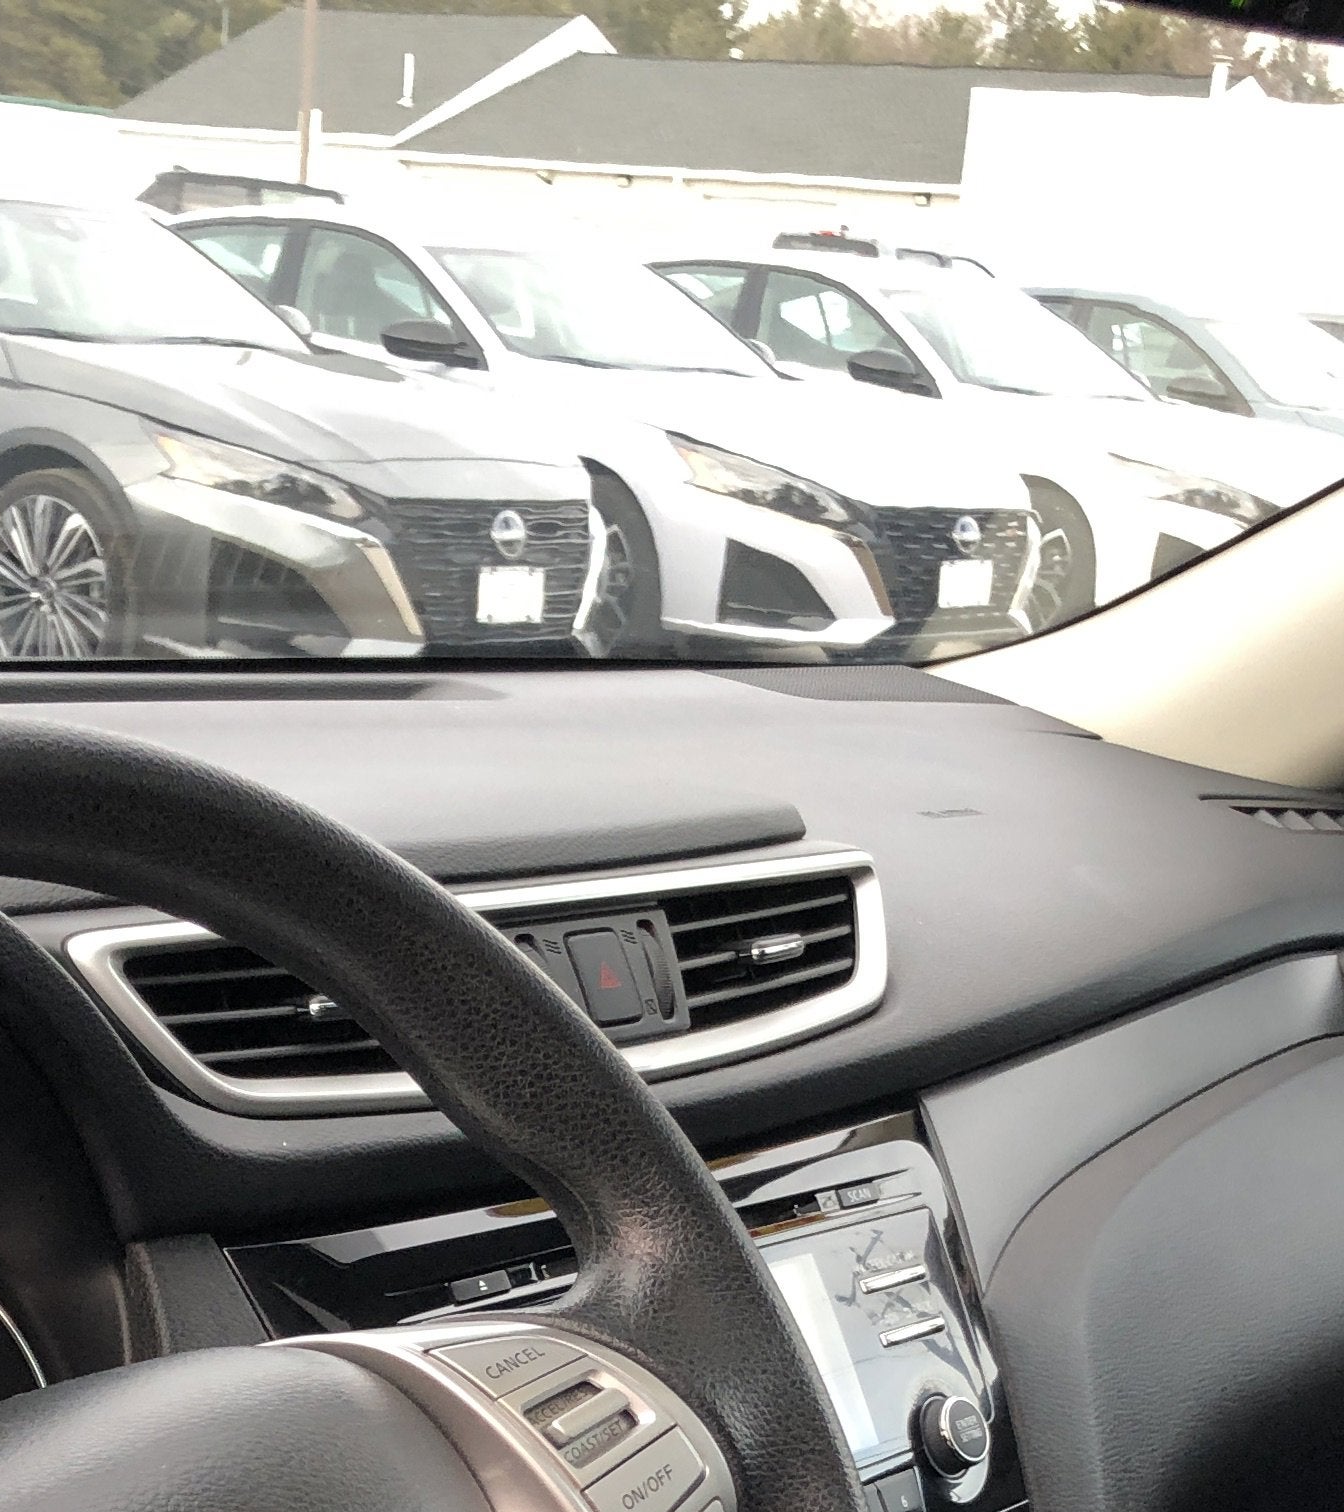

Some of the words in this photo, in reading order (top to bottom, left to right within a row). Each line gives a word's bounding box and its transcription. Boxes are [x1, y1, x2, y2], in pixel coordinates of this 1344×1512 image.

[485, 1346, 546, 1380] CANCEL
[563, 1419, 624, 1464] COAST/SET
[621, 1463, 674, 1511] ON/OFF
[900, 1495, 909, 1508] 6
